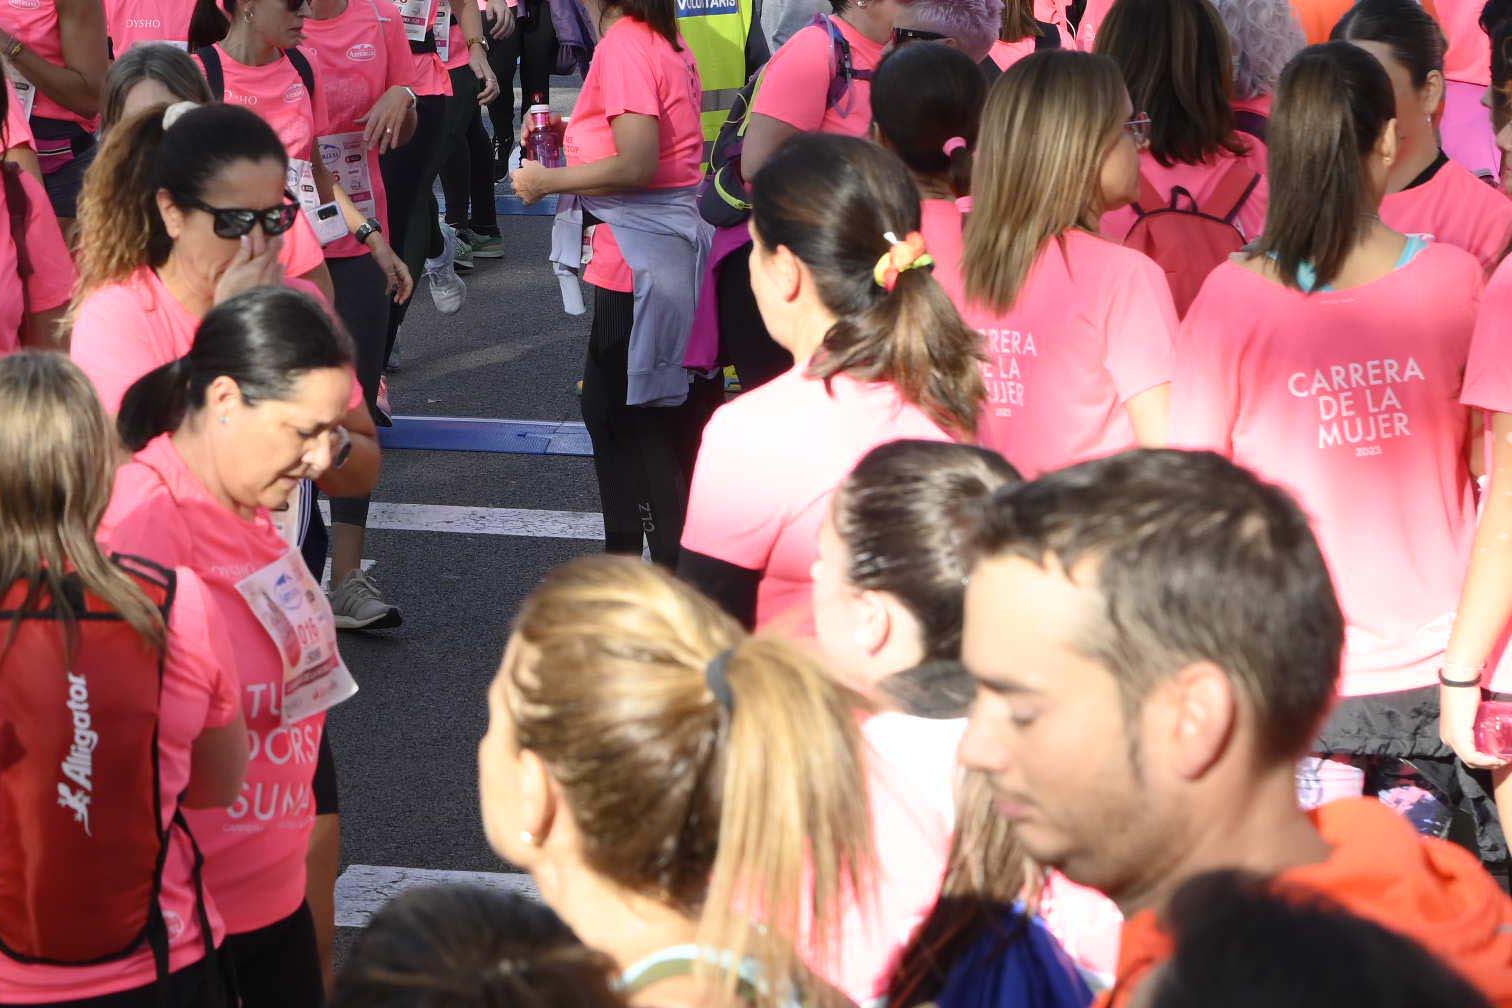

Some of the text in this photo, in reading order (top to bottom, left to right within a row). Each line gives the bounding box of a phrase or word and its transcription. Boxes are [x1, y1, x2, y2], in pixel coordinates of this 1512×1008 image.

[999, 356, 1021, 380] LA
[1288, 356, 1425, 398] CARRERA
[1318, 386, 1402, 421] DE LA
[1317, 411, 1412, 449] MUJER
[61, 671, 100, 791] Alligator
